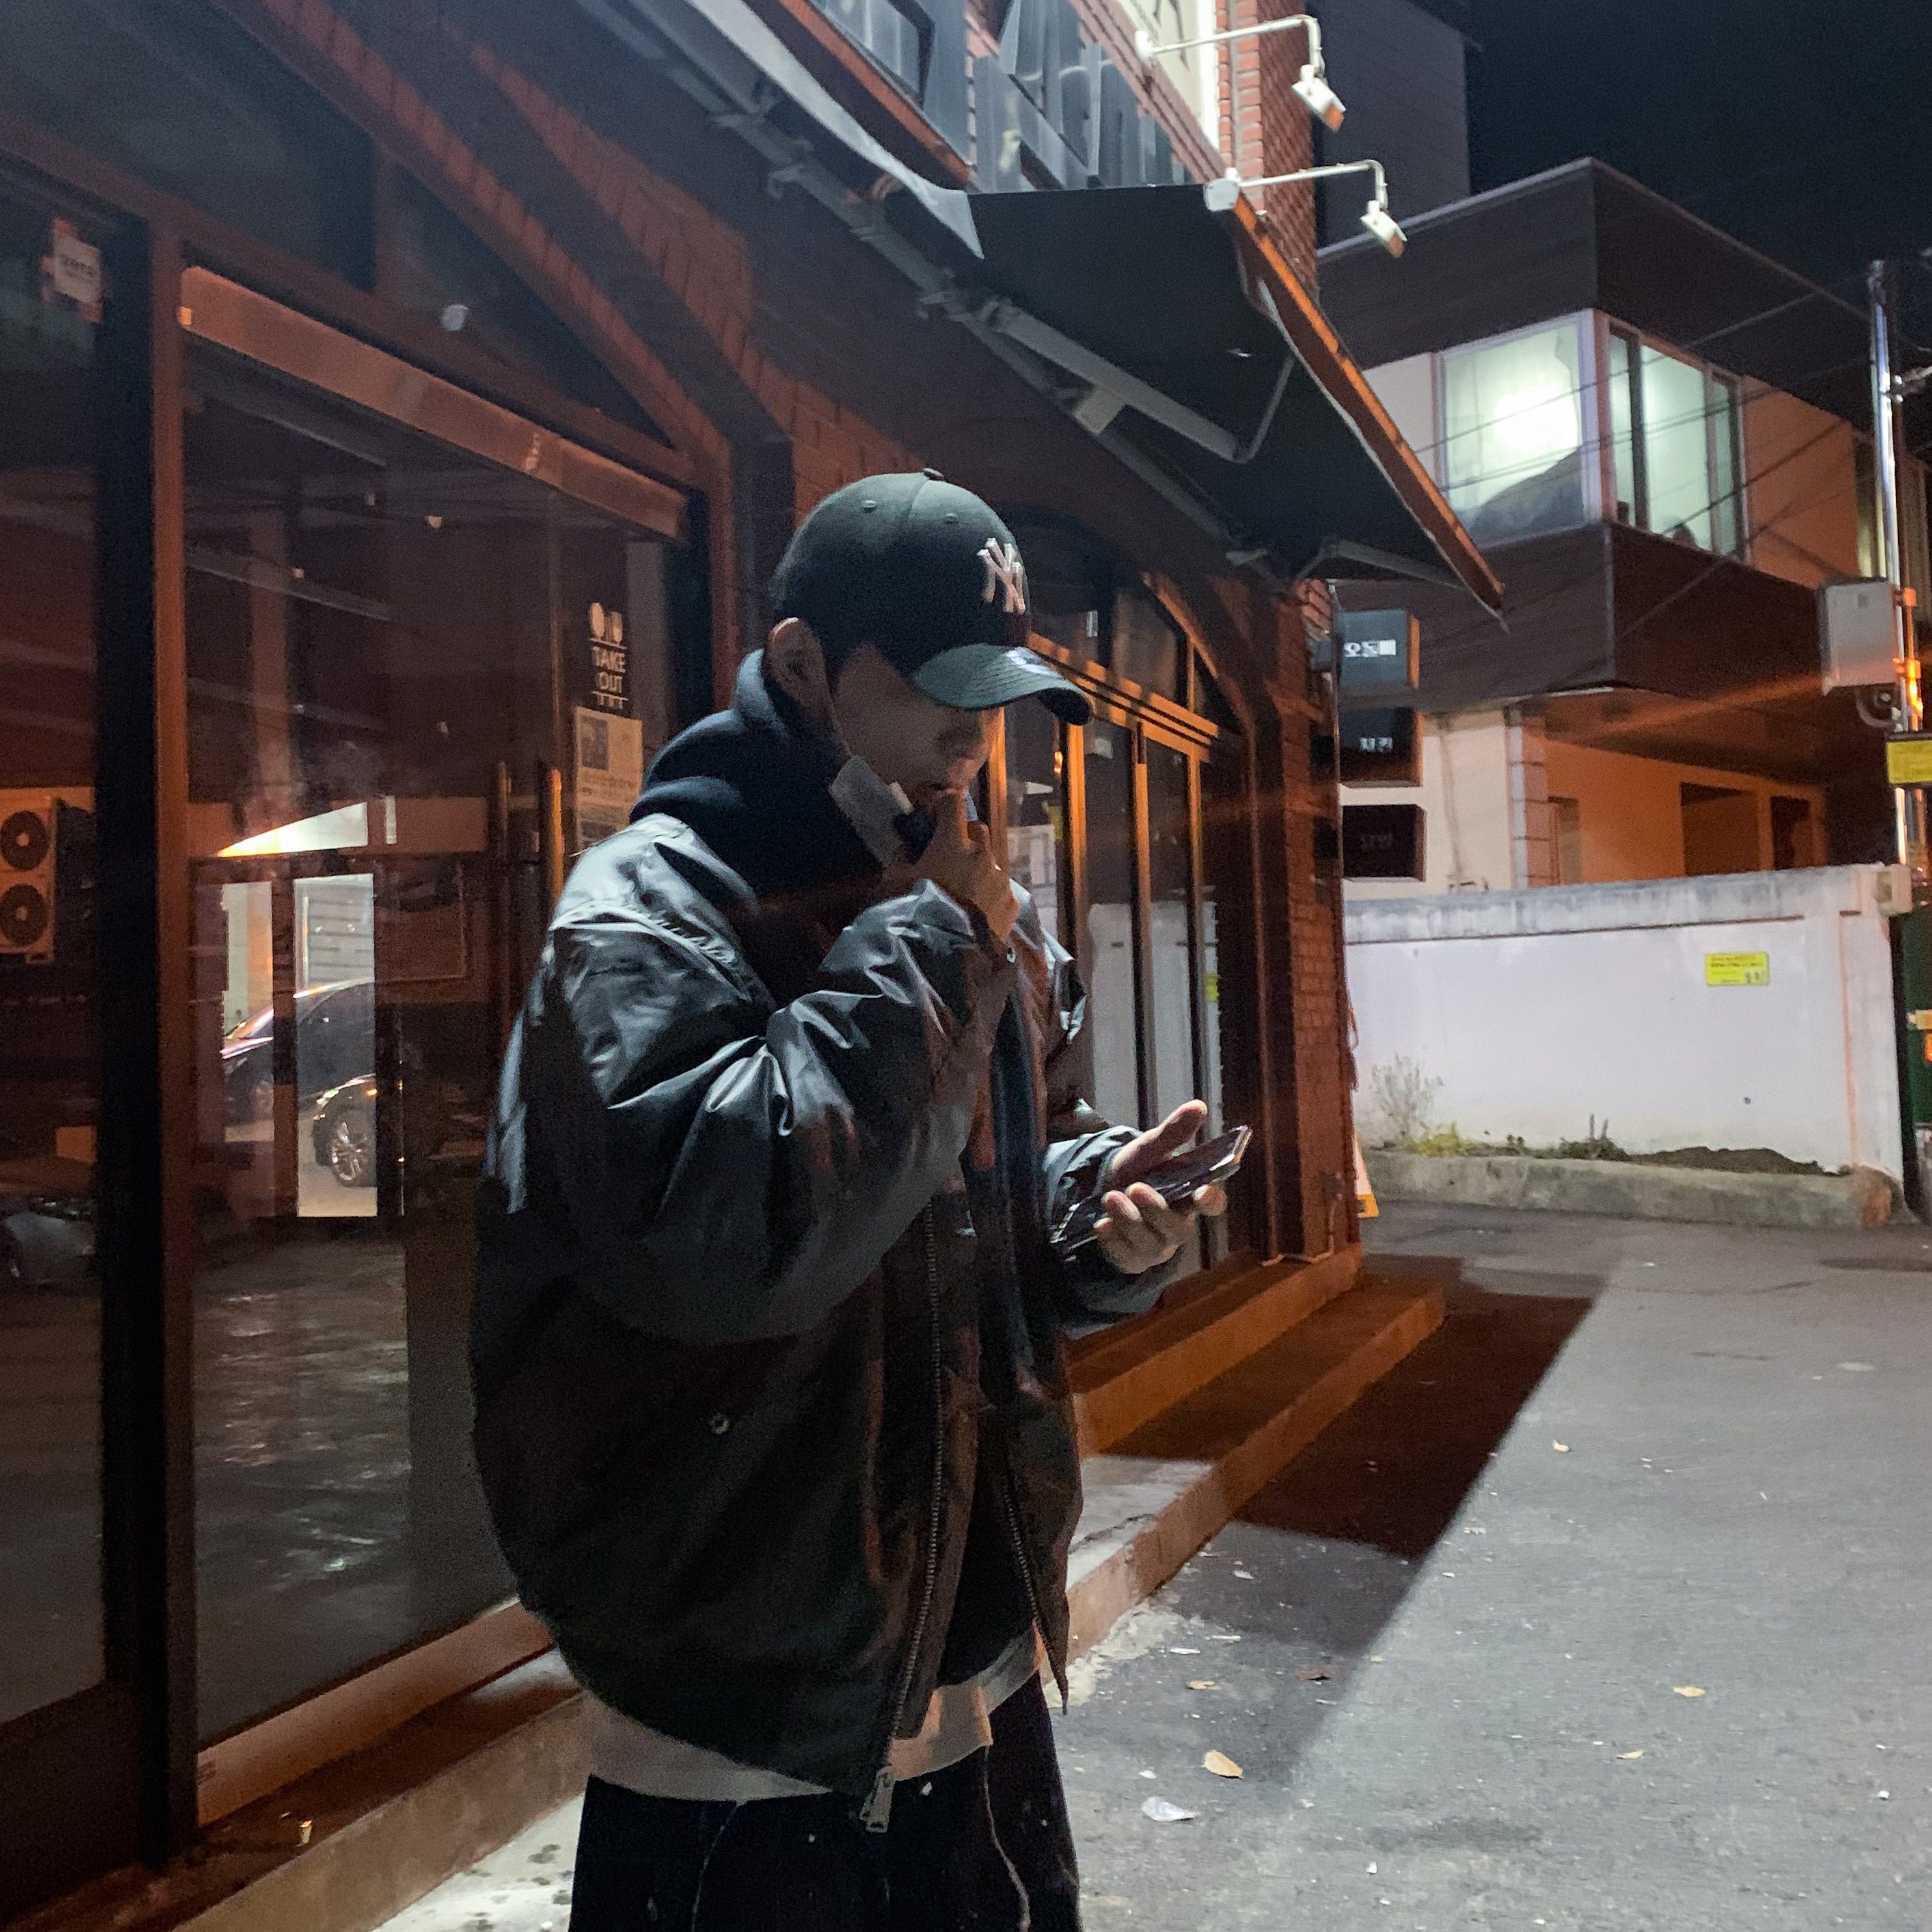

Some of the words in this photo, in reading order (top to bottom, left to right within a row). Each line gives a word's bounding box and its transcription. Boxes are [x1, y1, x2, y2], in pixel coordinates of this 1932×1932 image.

[977, 537, 1026, 615] NY
[592, 646, 625, 673] TAKE
[597, 672, 623, 694] OUT
